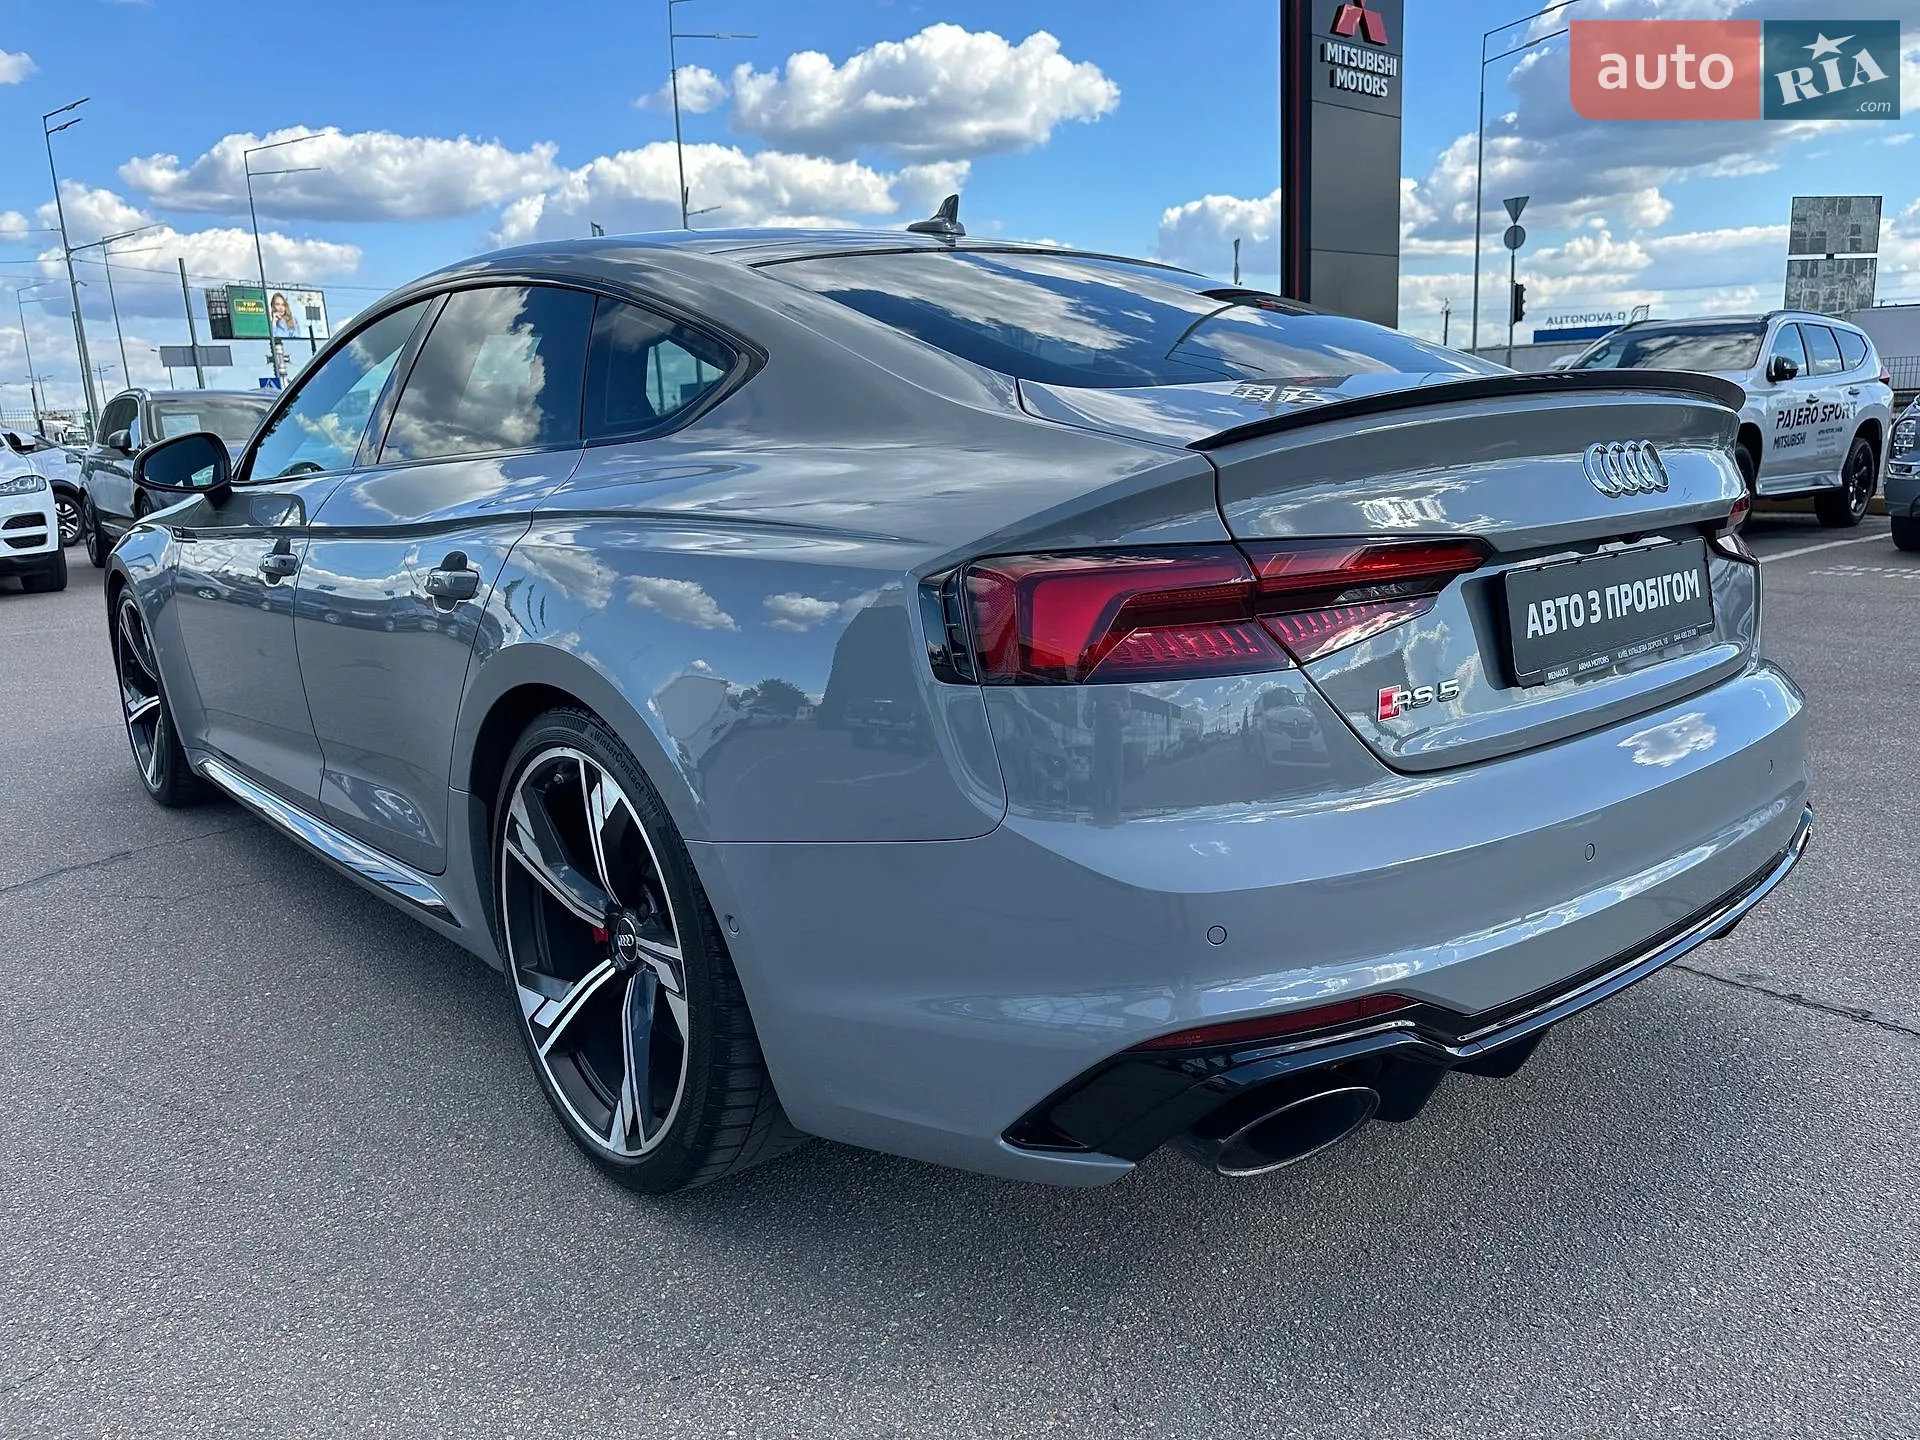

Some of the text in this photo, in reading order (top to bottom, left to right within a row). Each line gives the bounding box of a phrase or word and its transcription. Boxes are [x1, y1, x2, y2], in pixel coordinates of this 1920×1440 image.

[1326, 42, 1397, 77] MITSUBISHI
[1336, 68, 1388, 97] MOTORS
[1546, 311, 1626, 325] AUTONOVA-D
[1776, 401, 1857, 430] PAJERO SPORT
[1526, 568, 1701, 639] АВТО З ПРОБІГОМ
[1547, 667, 1569, 680] RENAULT
[1578, 655, 1610, 671] ARMA MOTORS
[1437, 679, 1460, 703] 5
